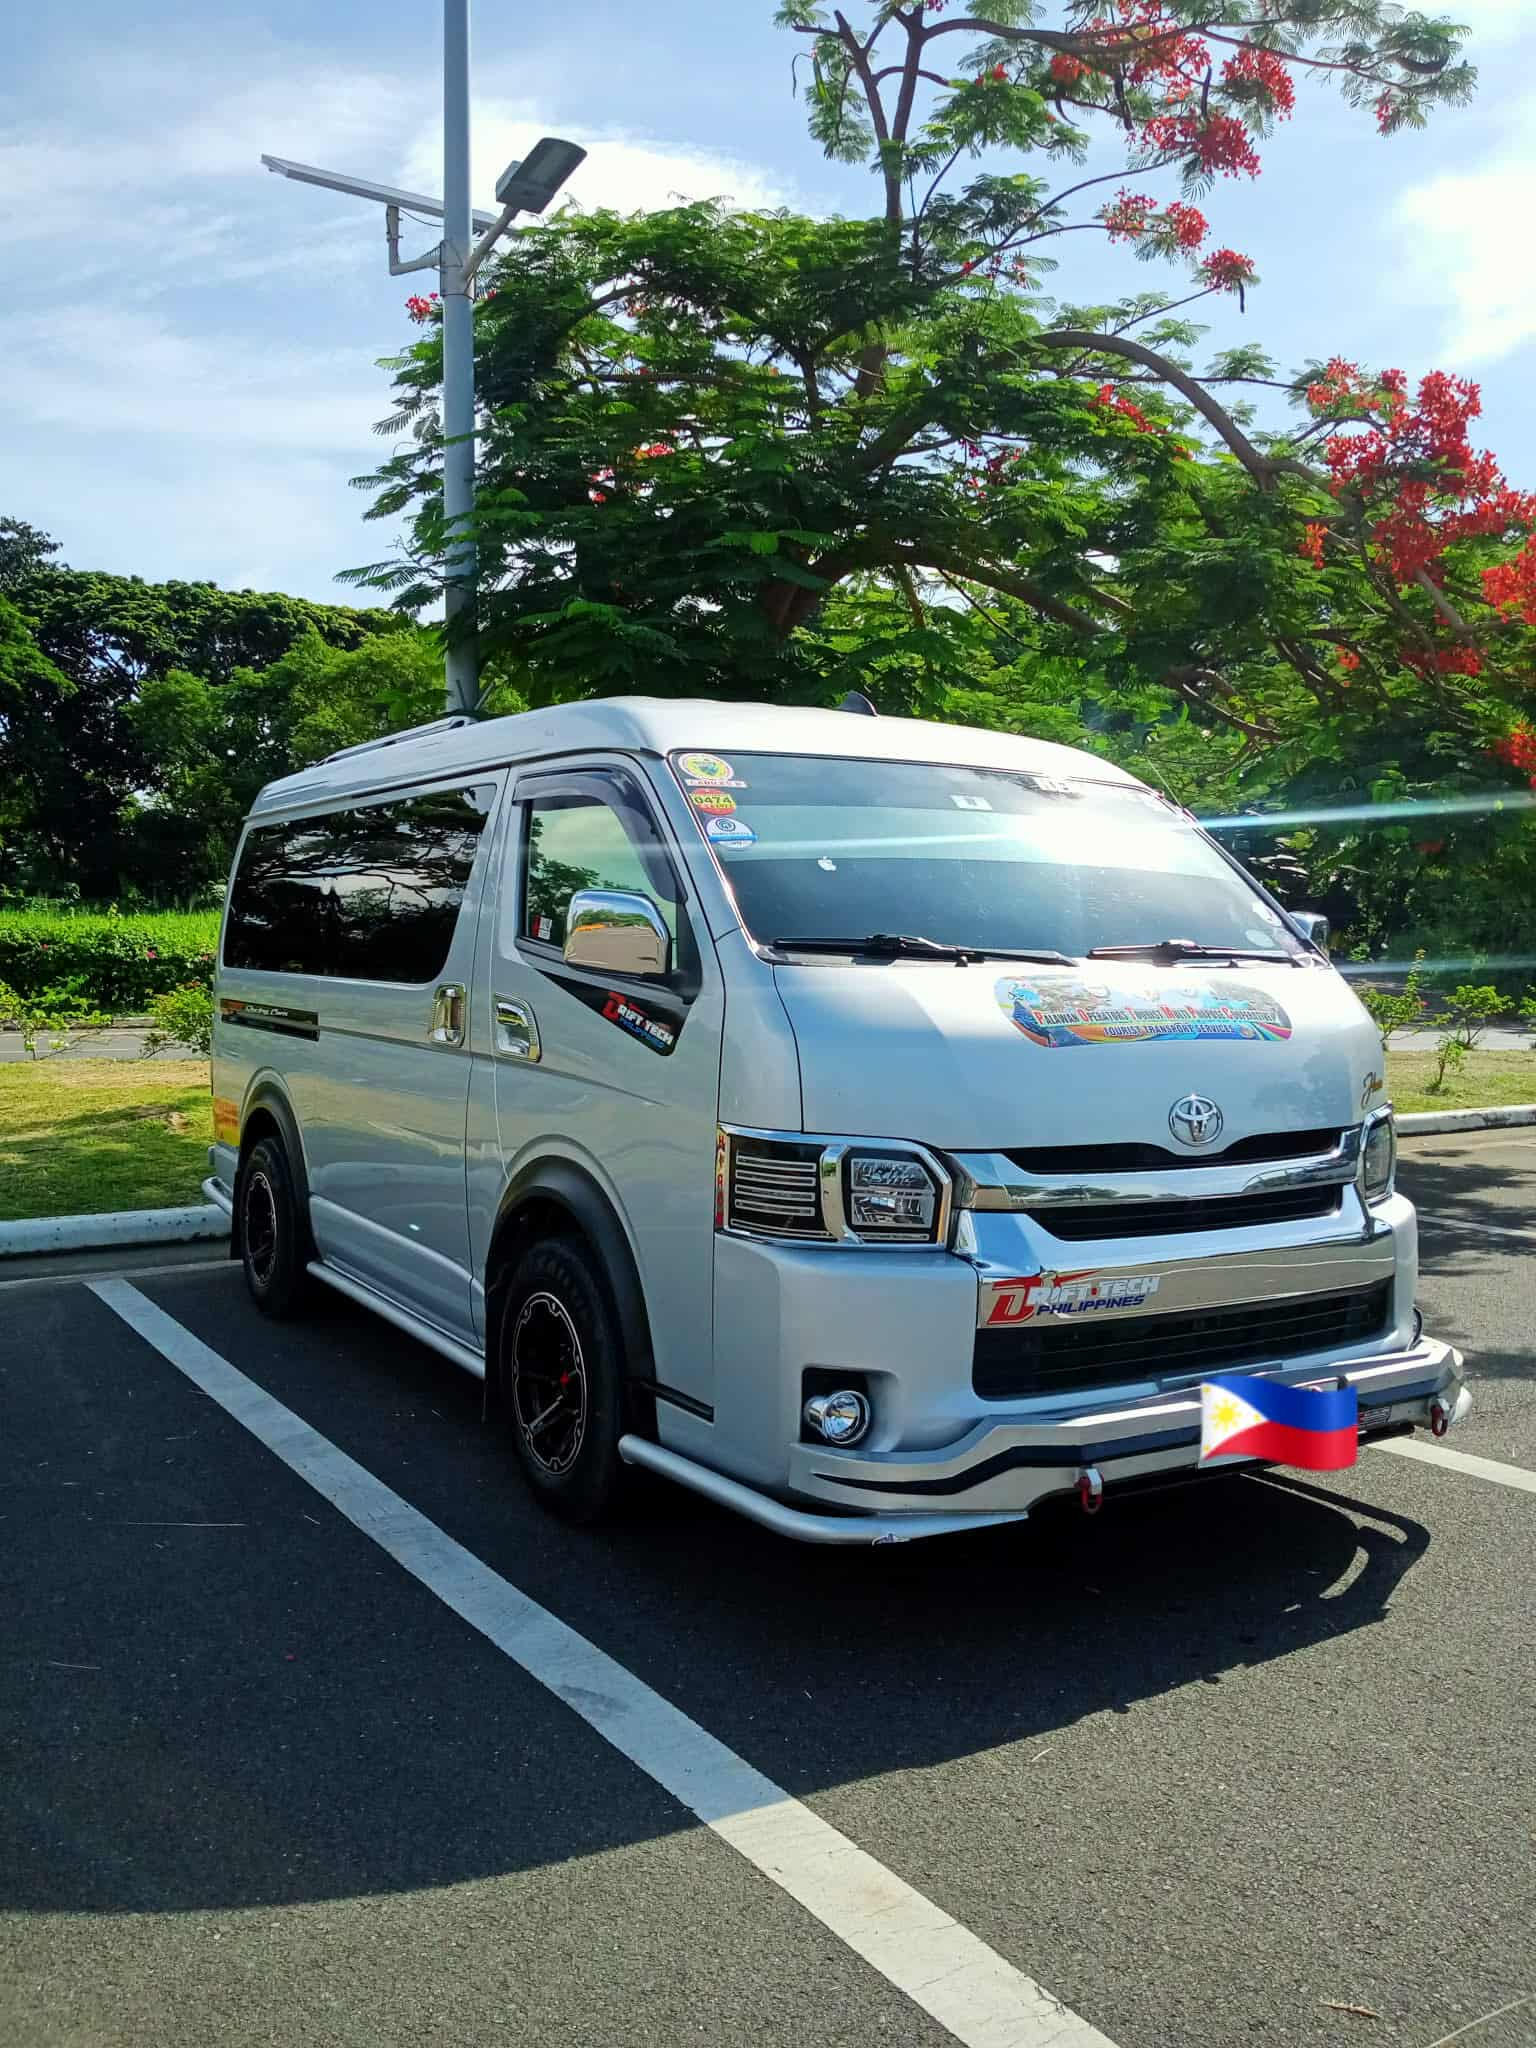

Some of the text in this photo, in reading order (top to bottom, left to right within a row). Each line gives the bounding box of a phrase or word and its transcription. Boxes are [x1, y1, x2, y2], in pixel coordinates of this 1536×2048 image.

[1034, 1010, 1079, 1025] PALAWAN
[1104, 1024, 1234, 1037] TOURIST TRANSPORT SERVICES
[1037, 1295, 1145, 1315] PHILIPPINES
